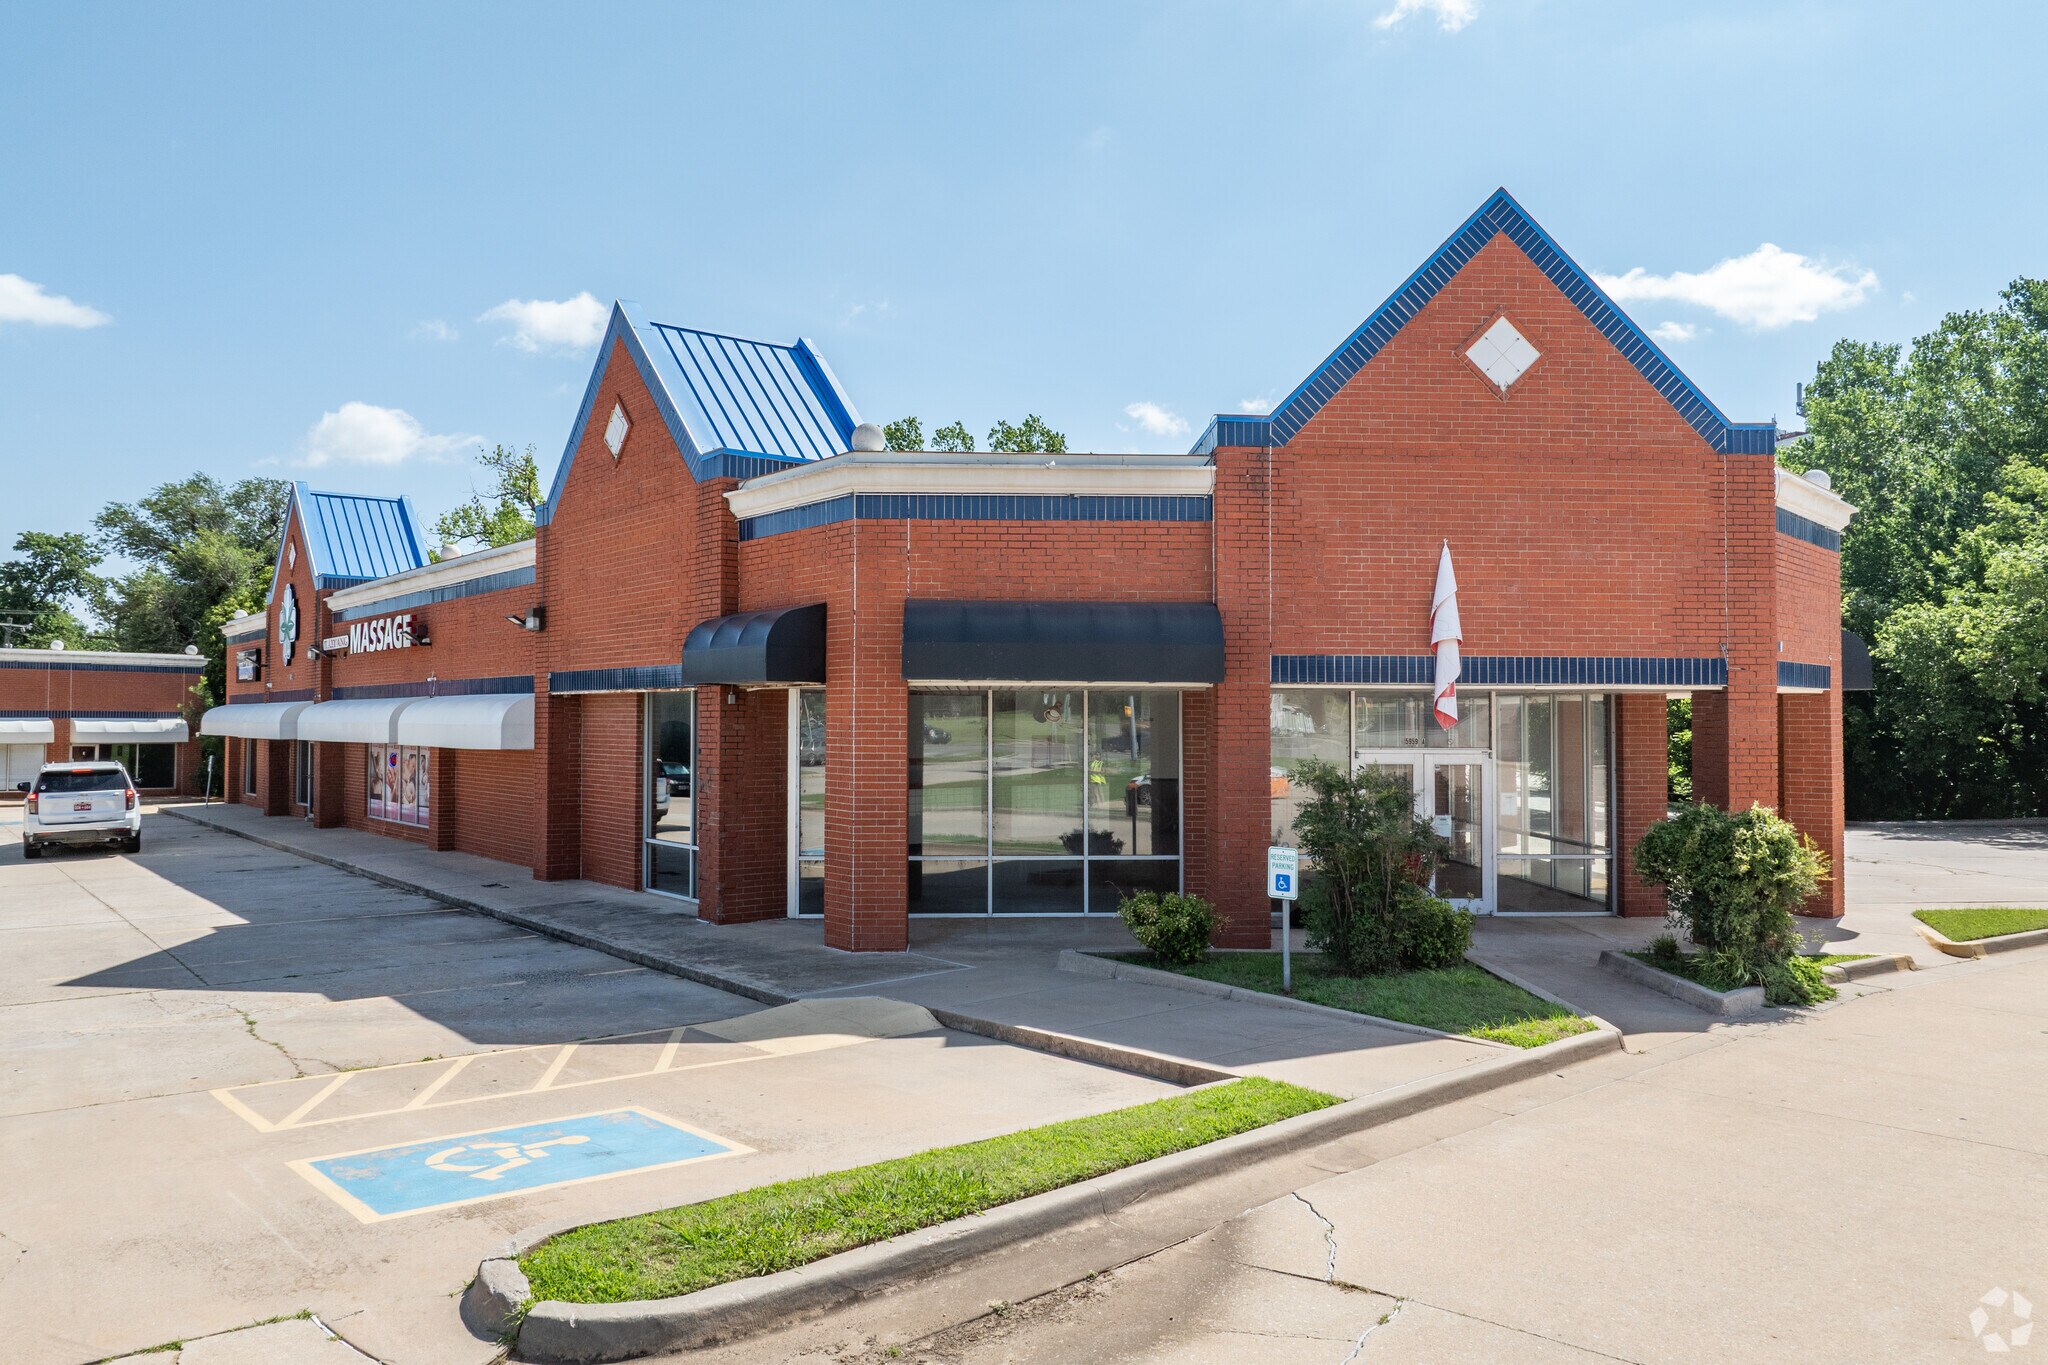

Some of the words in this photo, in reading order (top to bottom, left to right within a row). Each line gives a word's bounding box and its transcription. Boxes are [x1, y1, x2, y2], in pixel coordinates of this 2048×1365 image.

[350, 614, 411, 654] MASSAGE
[1271, 854, 1295, 862] RESERVED
[1272, 862, 1294, 870] PARKING
